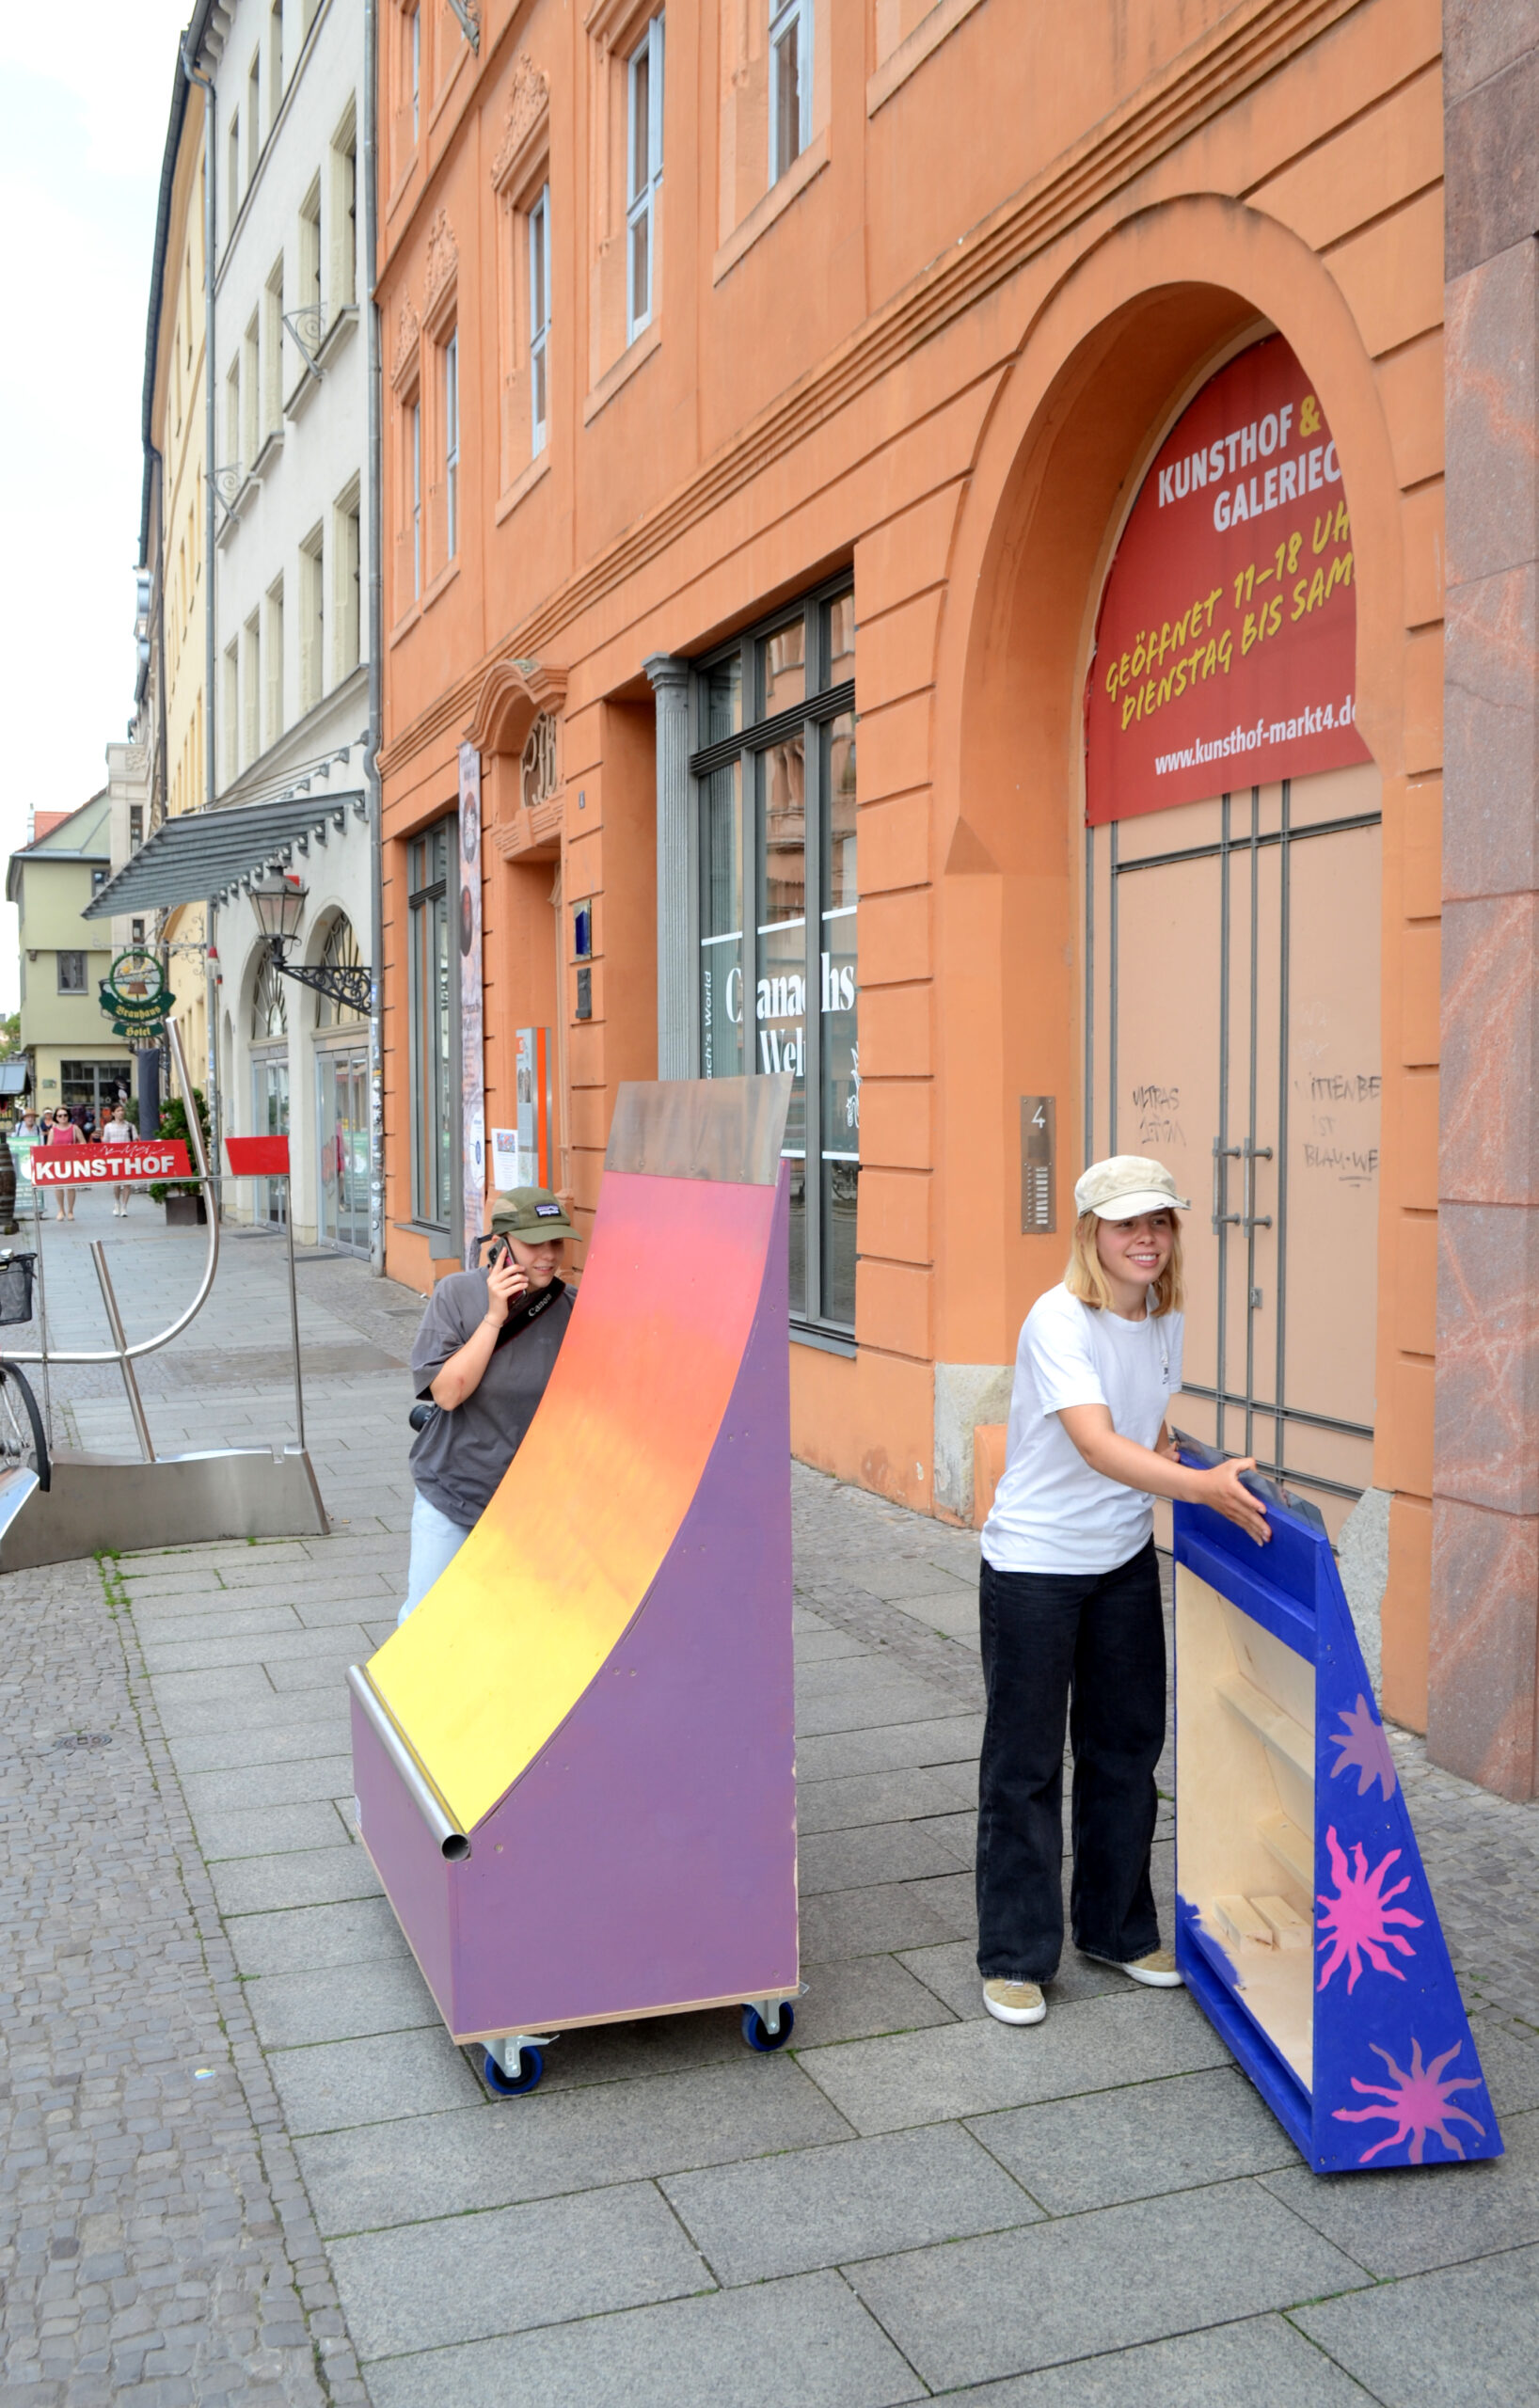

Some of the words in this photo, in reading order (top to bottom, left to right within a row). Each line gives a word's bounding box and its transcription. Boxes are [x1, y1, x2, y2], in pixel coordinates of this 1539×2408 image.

[1158, 403, 1293, 509] KUNSTHOF
[1298, 395, 1322, 437] &
[1214, 439, 1342, 532] GALERIEC
[1106, 588, 1223, 703] GEÖFFNET
[1120, 628, 1233, 731] DIENSTAG
[1241, 594, 1284, 656] BIS
[1290, 551, 1356, 622] SAM
[1154, 694, 1356, 775] www.kunsthof-markt4.d
[704, 970, 712, 1027] World
[759, 1027, 806, 1077] Wel
[1031, 1104, 1046, 1129] 4
[35, 1155, 175, 1180] KUNSTHOF
[528, 1293, 552, 1317] Canon
